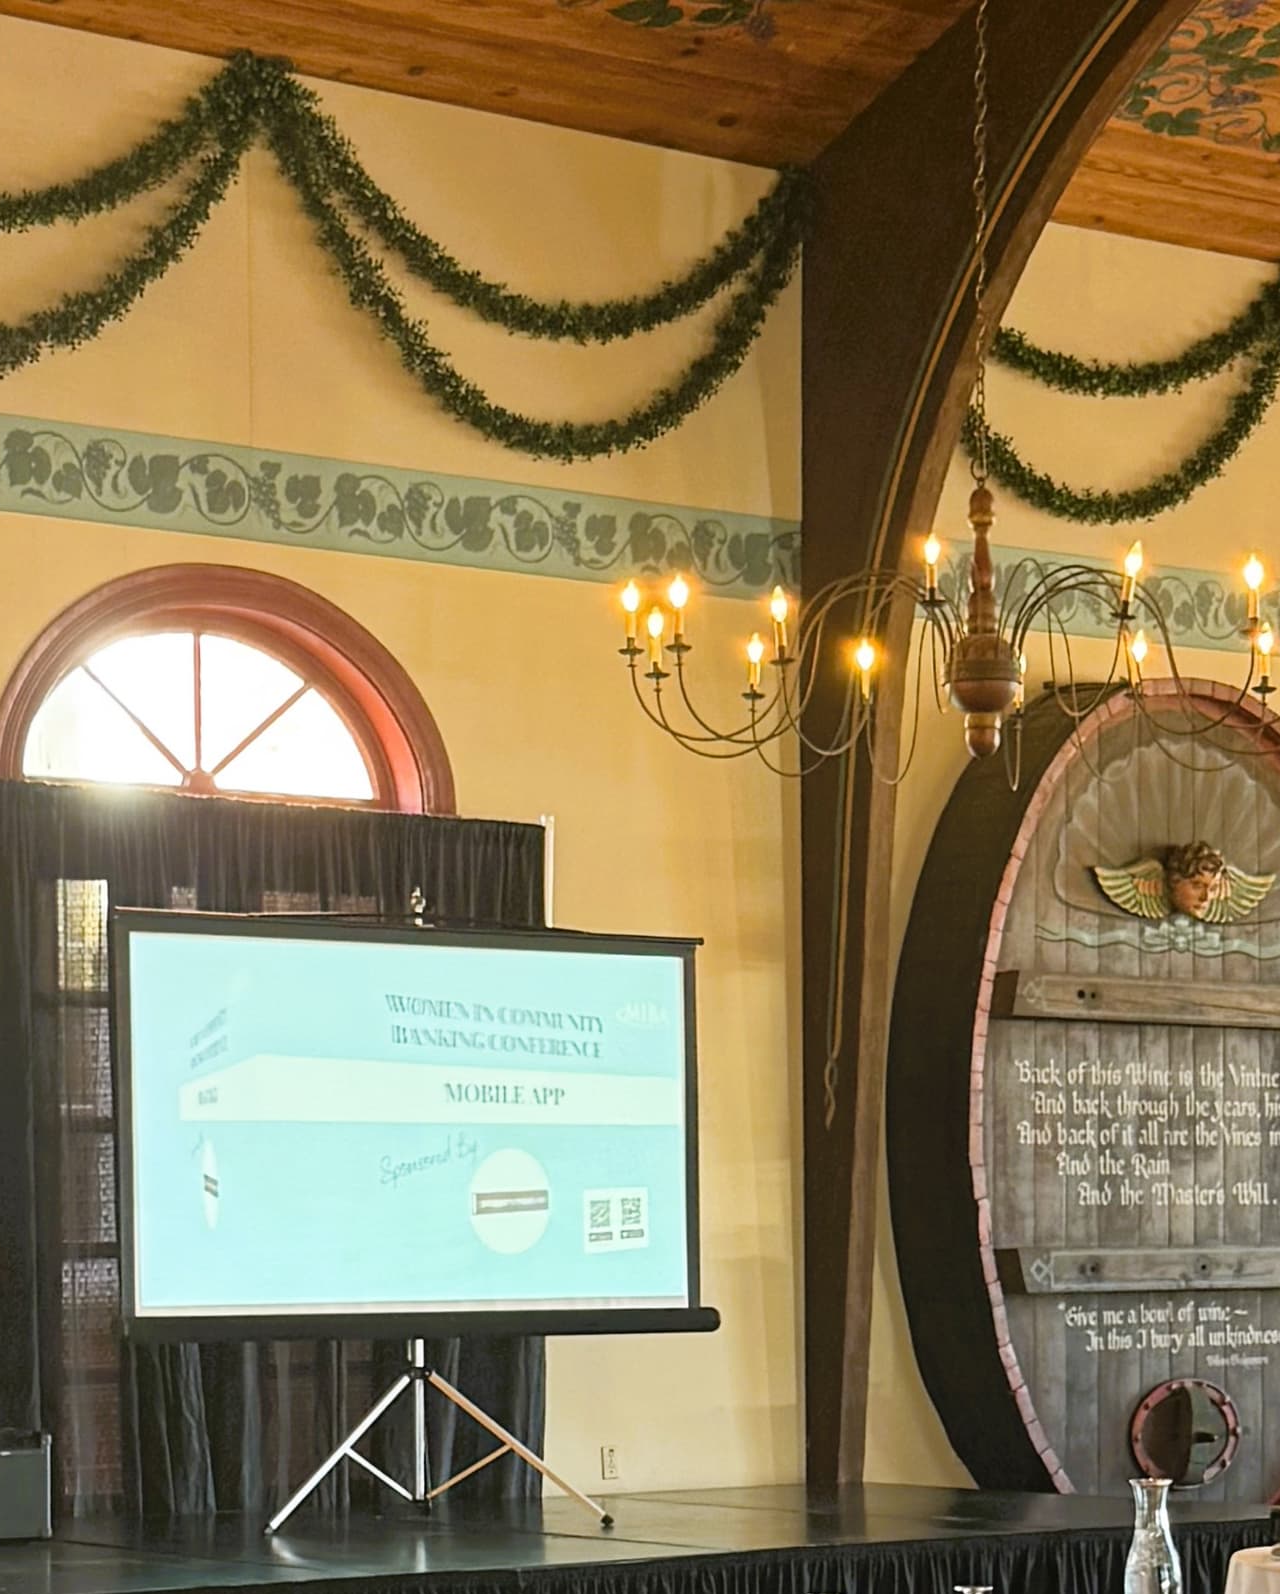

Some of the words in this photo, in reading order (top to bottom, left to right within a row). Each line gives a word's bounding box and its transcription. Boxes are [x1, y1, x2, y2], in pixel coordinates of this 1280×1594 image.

[385, 994, 470, 1019] WOMEN
[472, 1002, 496, 1021] IN
[497, 1006, 603, 1034] COMMUNITY
[391, 1025, 486, 1050] BANKING
[487, 1030, 602, 1059] CONFERENCE
[1015, 1059, 1062, 1087] Back
[1067, 1061, 1088, 1085] of
[1091, 1060, 1121, 1086] this
[1126, 1062, 1172, 1086] Wine
[1179, 1064, 1193, 1087] is
[1200, 1062, 1223, 1088] the
[444, 1083, 524, 1105] MOBILE
[531, 1086, 565, 1106] APP
[1031, 1091, 1066, 1115] And
[1073, 1090, 1113, 1119] back
[1117, 1090, 1179, 1122] through
[1186, 1090, 1209, 1118] the
[1017, 1120, 1052, 1145] And
[1057, 1120, 1097, 1149] back
[1100, 1122, 1119, 1145] of
[1122, 1124, 1134, 1146] it
[1138, 1120, 1158, 1146] all
[1163, 1128, 1188, 1146] are
[1195, 1120, 1218, 1147] the
[1220, 1121, 1262, 1146] Vines
[1056, 1152, 1091, 1176] And
[1099, 1150, 1125, 1176] the
[1131, 1151, 1170, 1179] Rain
[1078, 1181, 1112, 1206] And
[1120, 1179, 1144, 1208] the
[1103, 1309, 1124, 1325] me
[1127, 1308, 1138, 1325] a
[1141, 1302, 1174, 1324] bowl
[1178, 1300, 1194, 1322] of
[1085, 1329, 1105, 1352] In
[1108, 1327, 1133, 1351] this
[1151, 1328, 1185, 1354] bury
[1188, 1325, 1205, 1347] all
